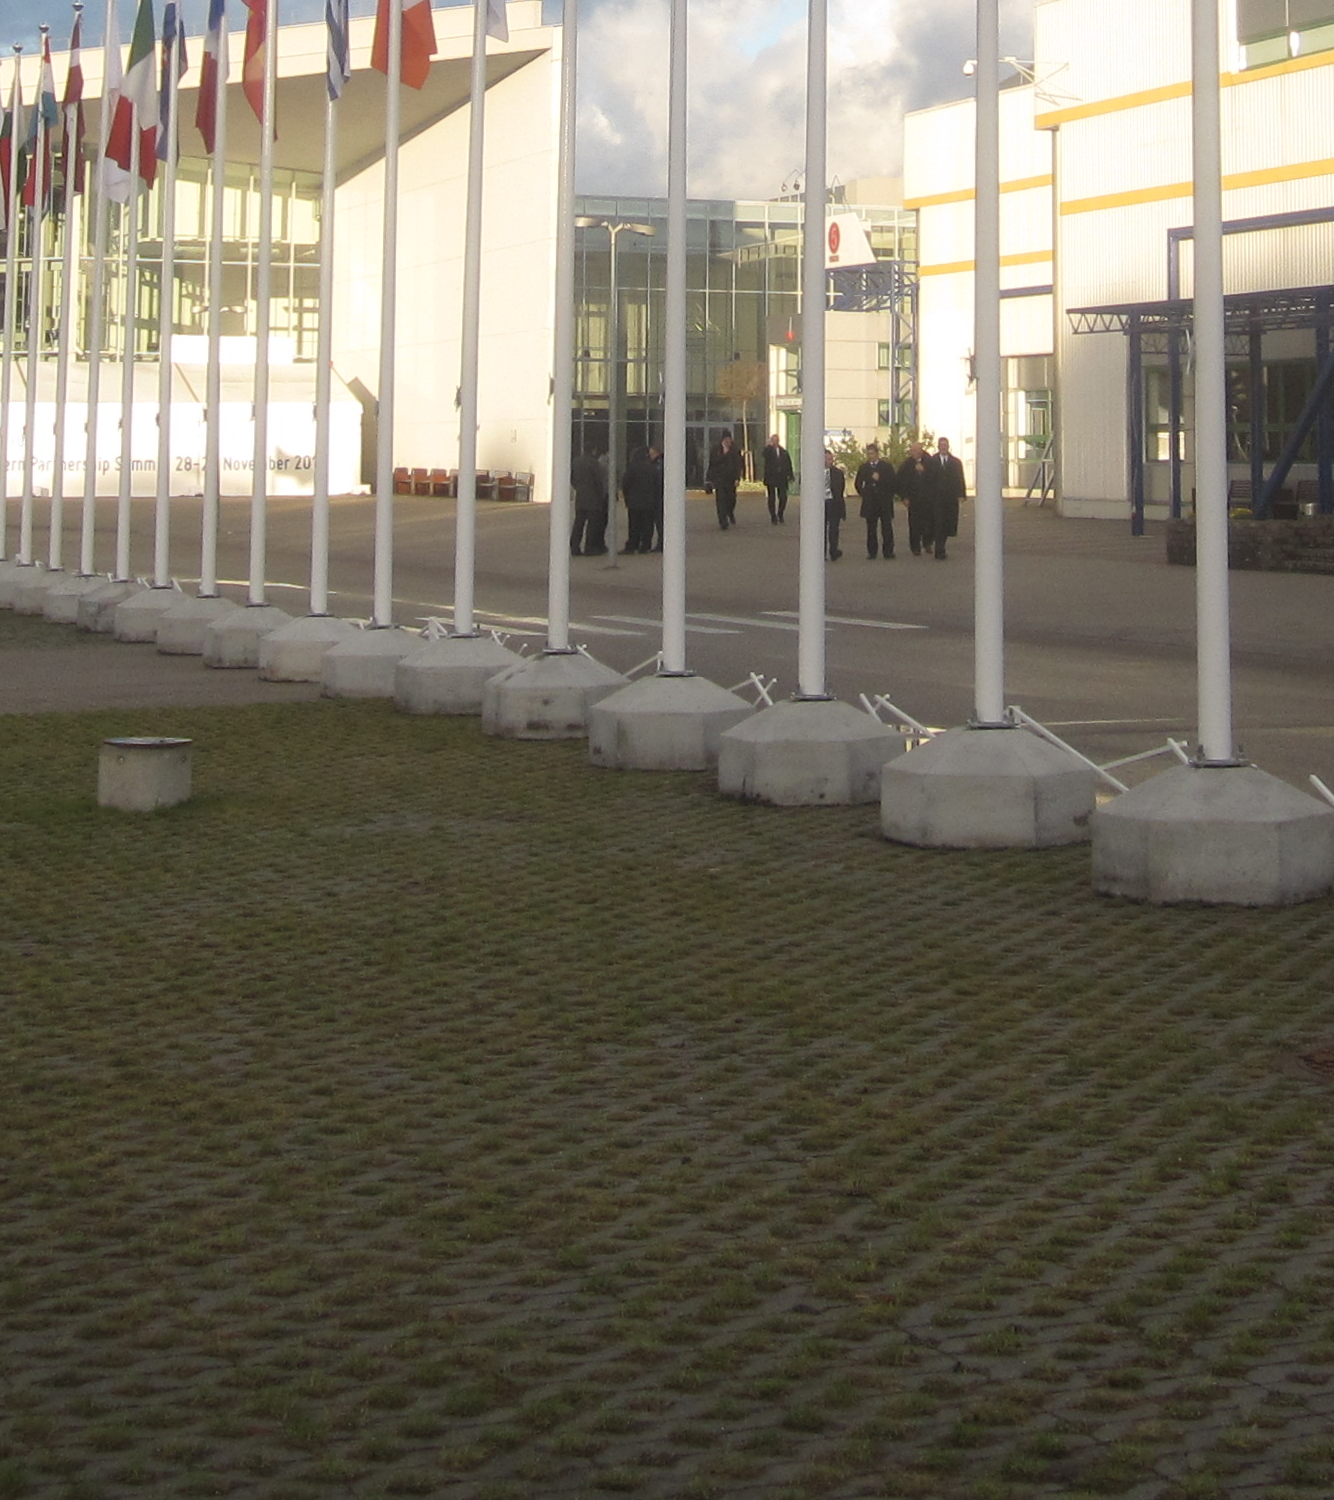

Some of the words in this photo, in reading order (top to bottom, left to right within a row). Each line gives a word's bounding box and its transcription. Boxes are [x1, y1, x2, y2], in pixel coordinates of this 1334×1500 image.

[31, 456, 110, 476] Parnersip
[114, 456, 165, 471] Smm
[175, 456, 215, 471] 28-2
[223, 455, 289, 471] Noveber
